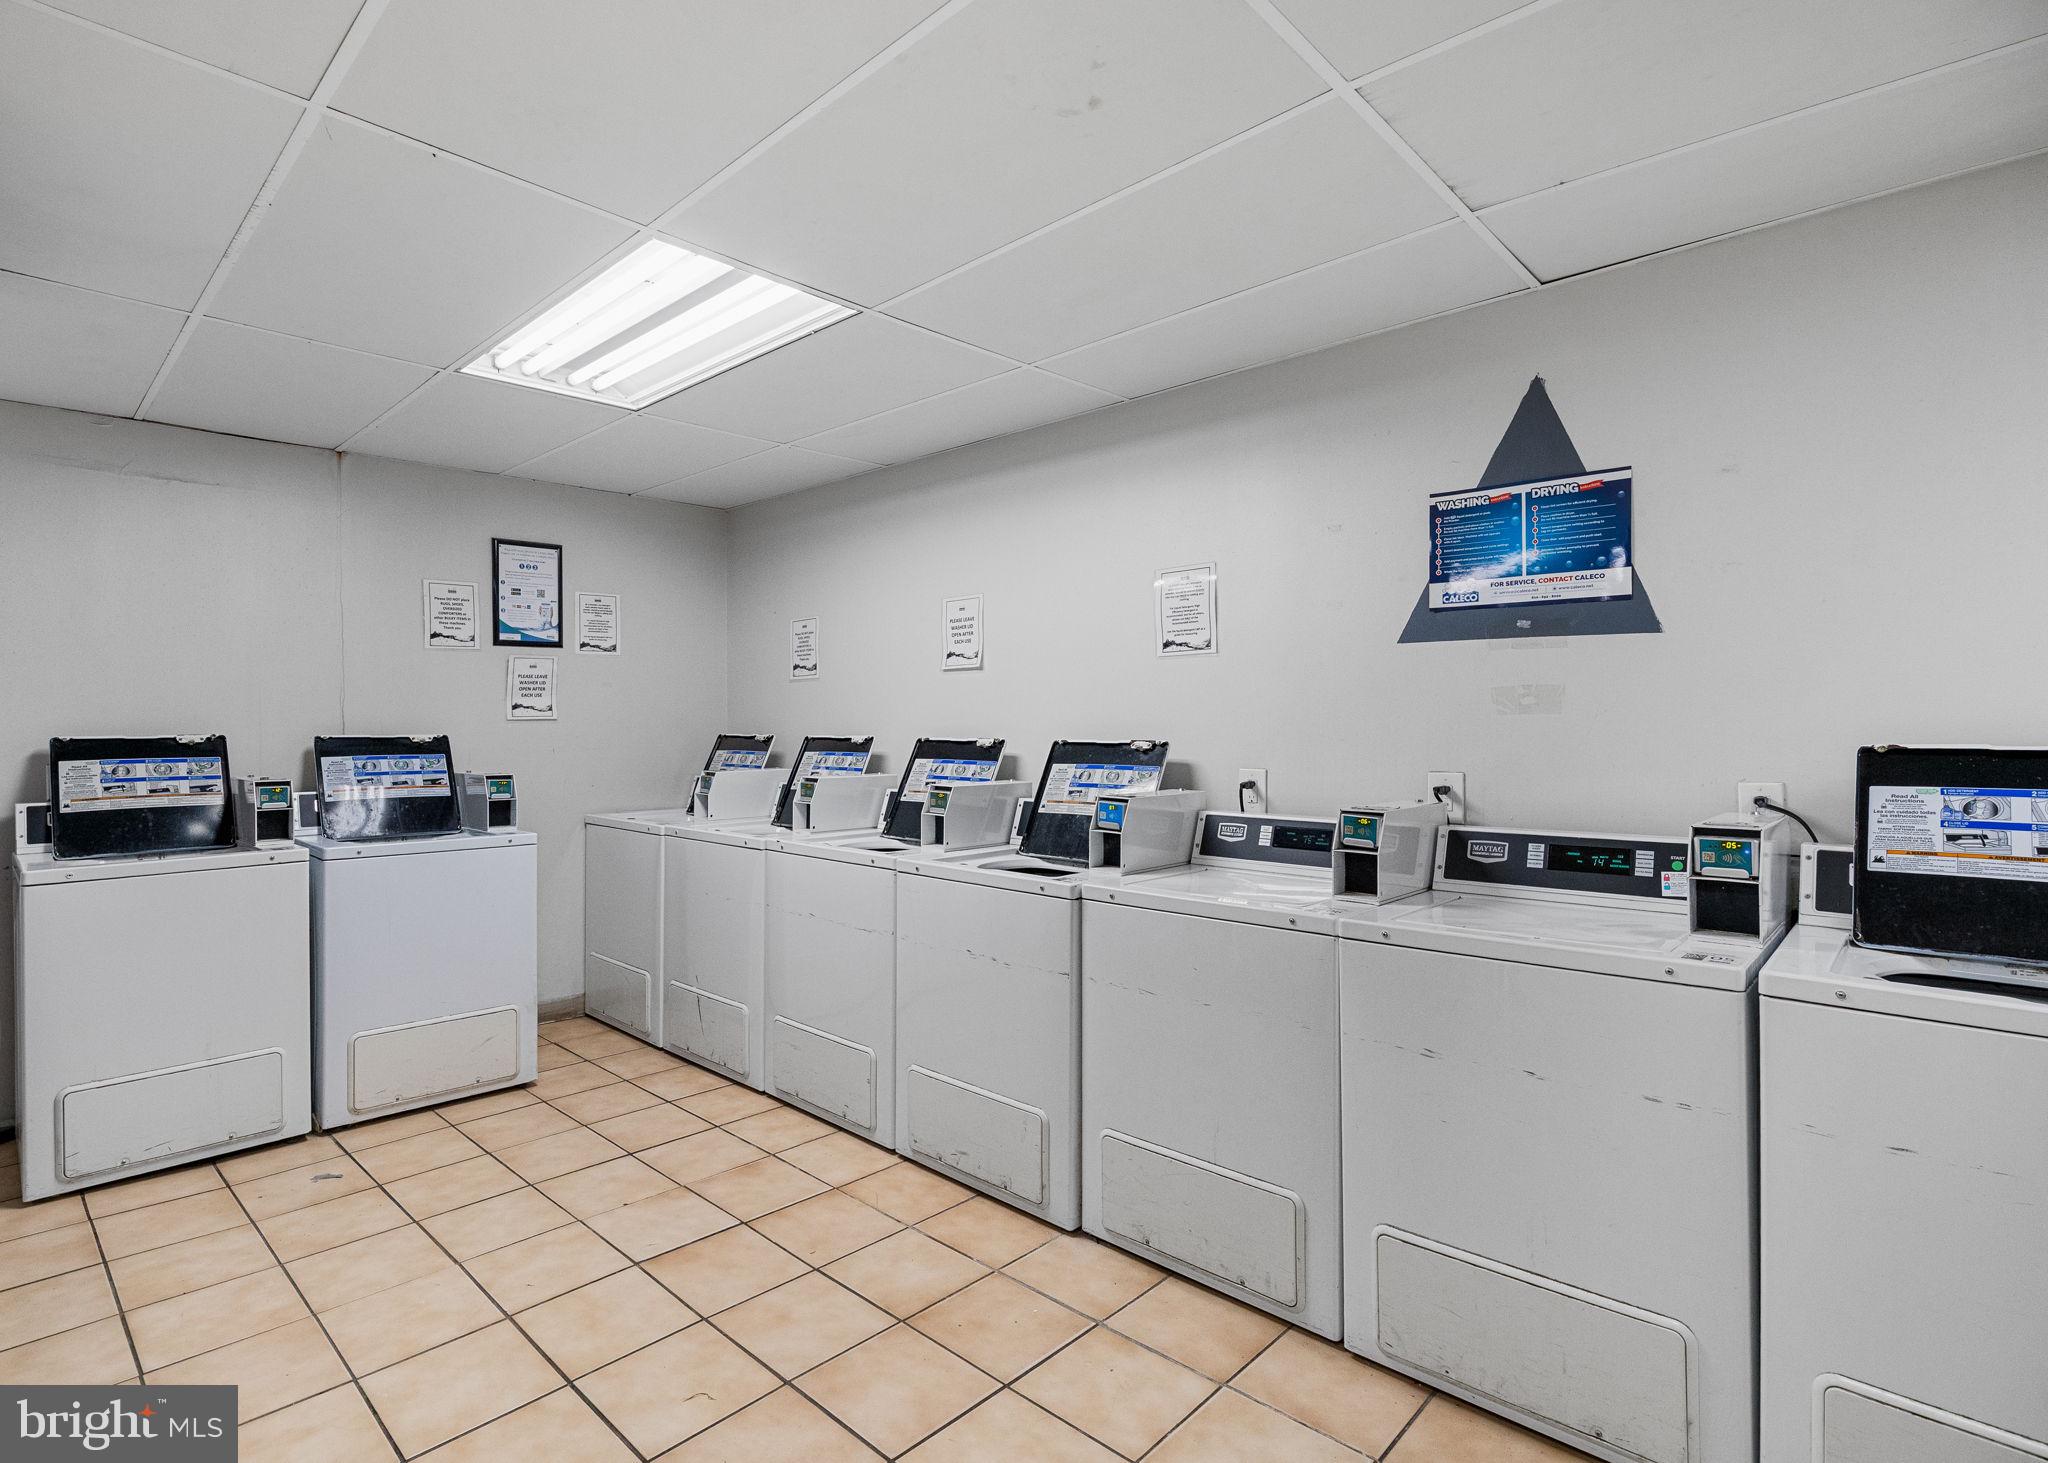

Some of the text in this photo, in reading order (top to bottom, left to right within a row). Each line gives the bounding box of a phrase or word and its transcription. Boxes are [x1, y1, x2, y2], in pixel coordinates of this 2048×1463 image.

[1531, 483, 1579, 498] DRYING
[1436, 496, 1490, 511] WASHING
[1505, 578, 1537, 587] SERVICE,
[1538, 576, 1573, 584] CONTACT
[1574, 572, 1605, 581] CALECO
[1443, 593, 1478, 604] CALECO
[1472, 844, 1504, 853] MAYTAG
